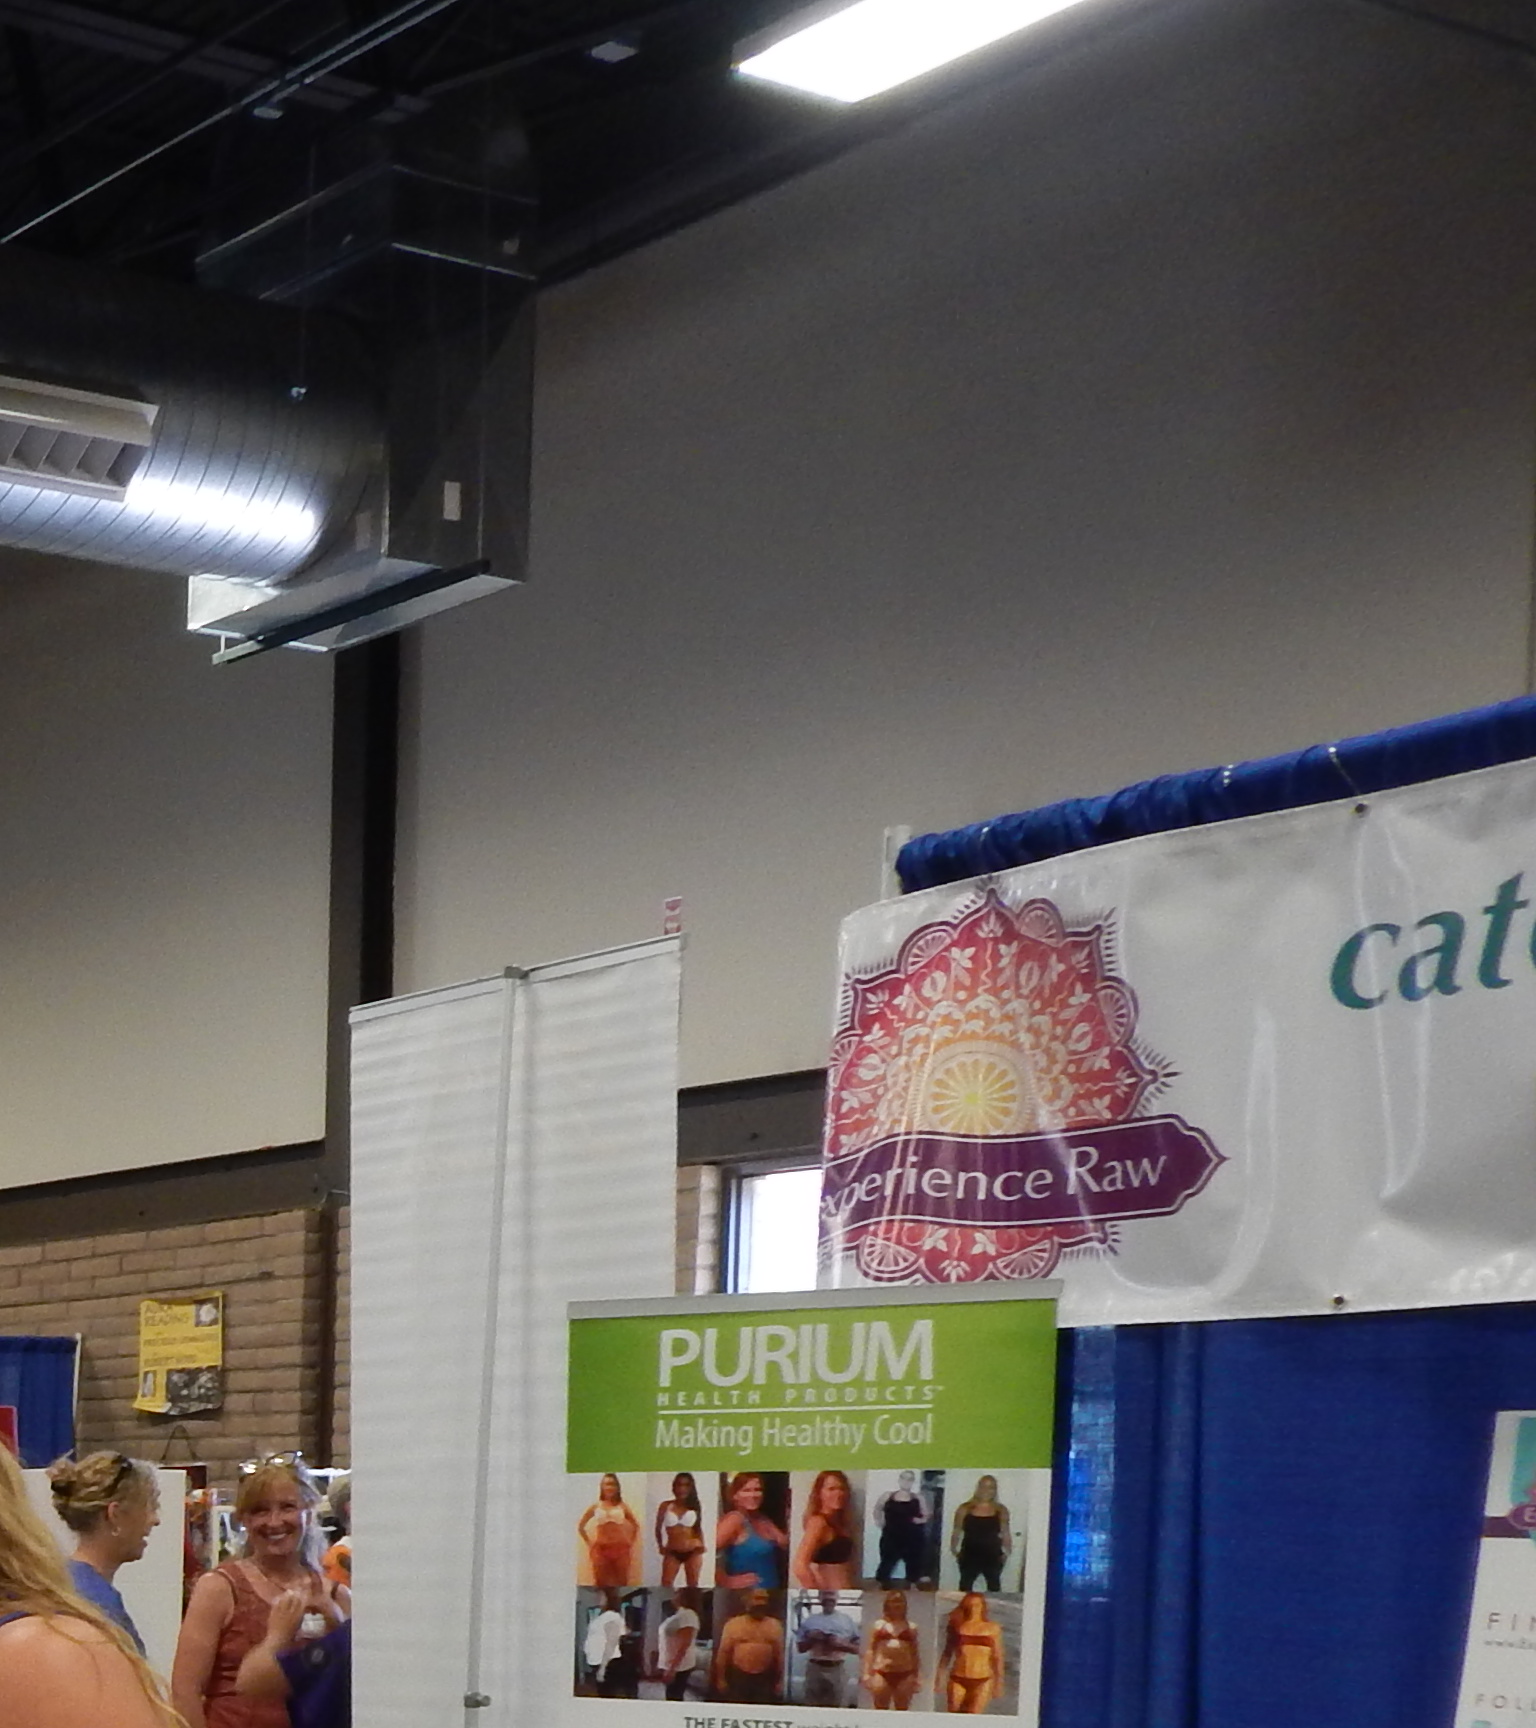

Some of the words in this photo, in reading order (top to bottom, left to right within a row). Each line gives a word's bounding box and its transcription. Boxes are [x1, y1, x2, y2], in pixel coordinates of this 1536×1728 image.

[821, 1161, 1053, 1216] xperience
[1069, 1146, 1169, 1195] Raw
[657, 1318, 934, 1388] PURIUM
[657, 1389, 762, 1407] HEALTH
[655, 1414, 755, 1456] Making
[761, 1413, 867, 1454] Healthy
[872, 1413, 933, 1446] Cool
[1475, 1692, 1536, 1712] FOLL
